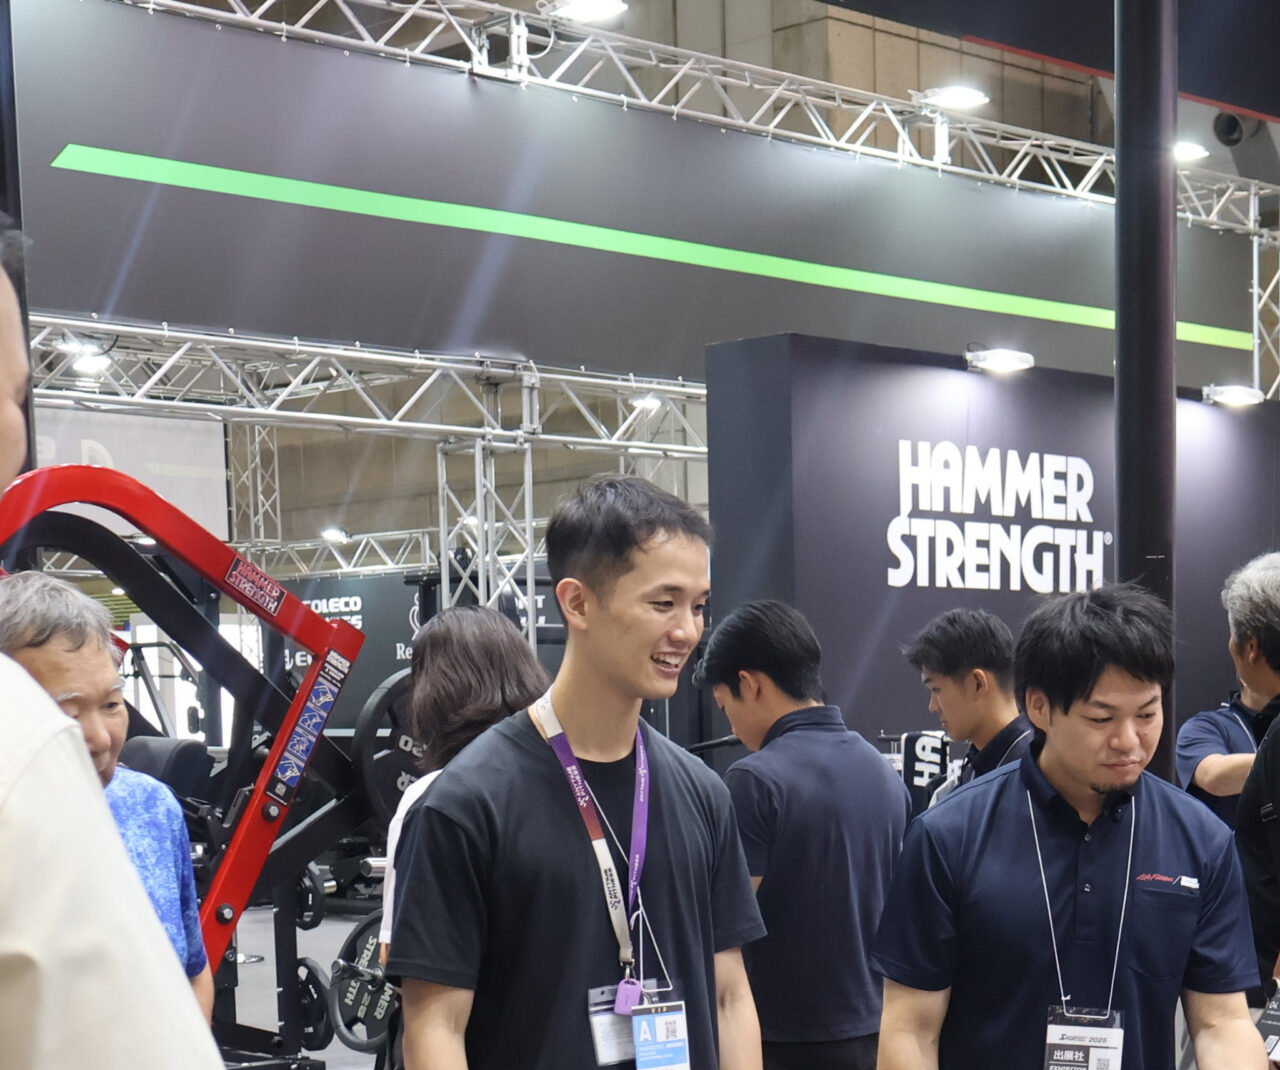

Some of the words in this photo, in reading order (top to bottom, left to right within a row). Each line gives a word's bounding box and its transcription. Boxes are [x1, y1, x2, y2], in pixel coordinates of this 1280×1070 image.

[899, 440, 1094, 523] HAMMER
[235, 560, 281, 600] HAMMER
[228, 571, 278, 613] STRENGTH
[651, 1006, 668, 1014] VIP
[639, 1020, 652, 1042] A
[1088, 1036, 1108, 1044] 2025
[1053, 1050, 1085, 1062] 出展社
